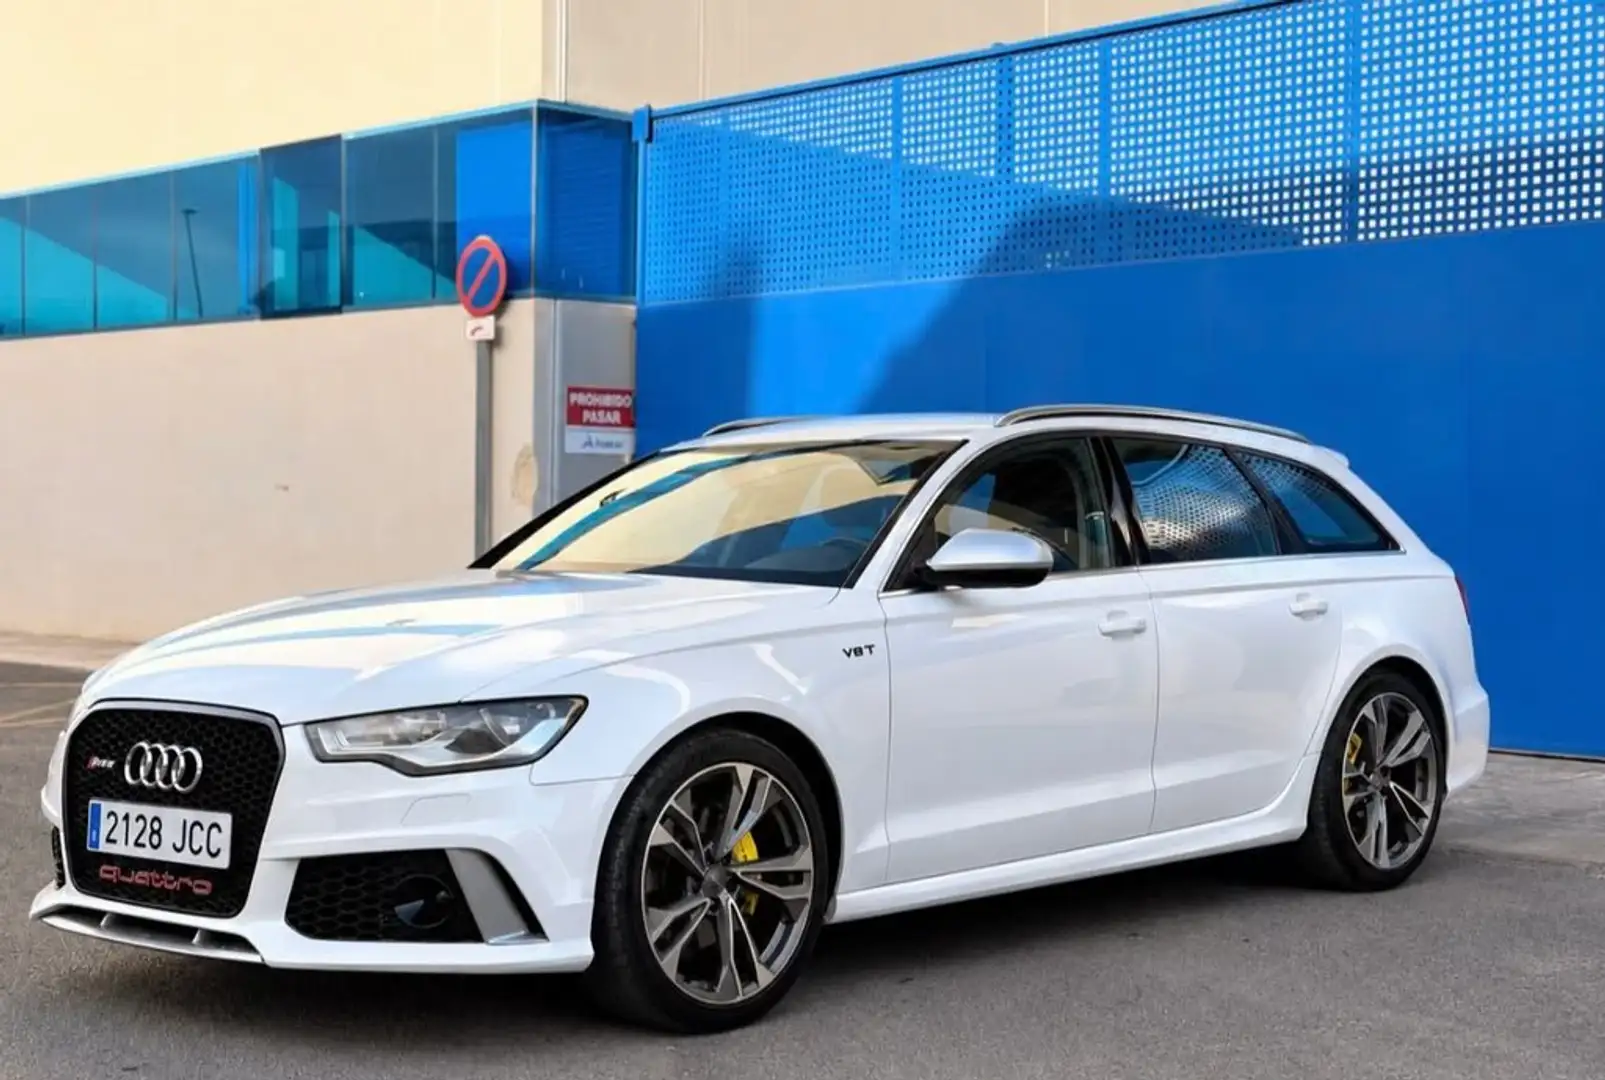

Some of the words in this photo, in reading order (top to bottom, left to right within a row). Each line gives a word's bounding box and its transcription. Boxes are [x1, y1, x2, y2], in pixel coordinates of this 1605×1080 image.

[569, 391, 632, 407] PROHIBIDO
[582, 409, 621, 424] PASAR
[105, 810, 163, 850] 2128
[172, 818, 223, 859] JCC
[100, 864, 213, 895] quattro
